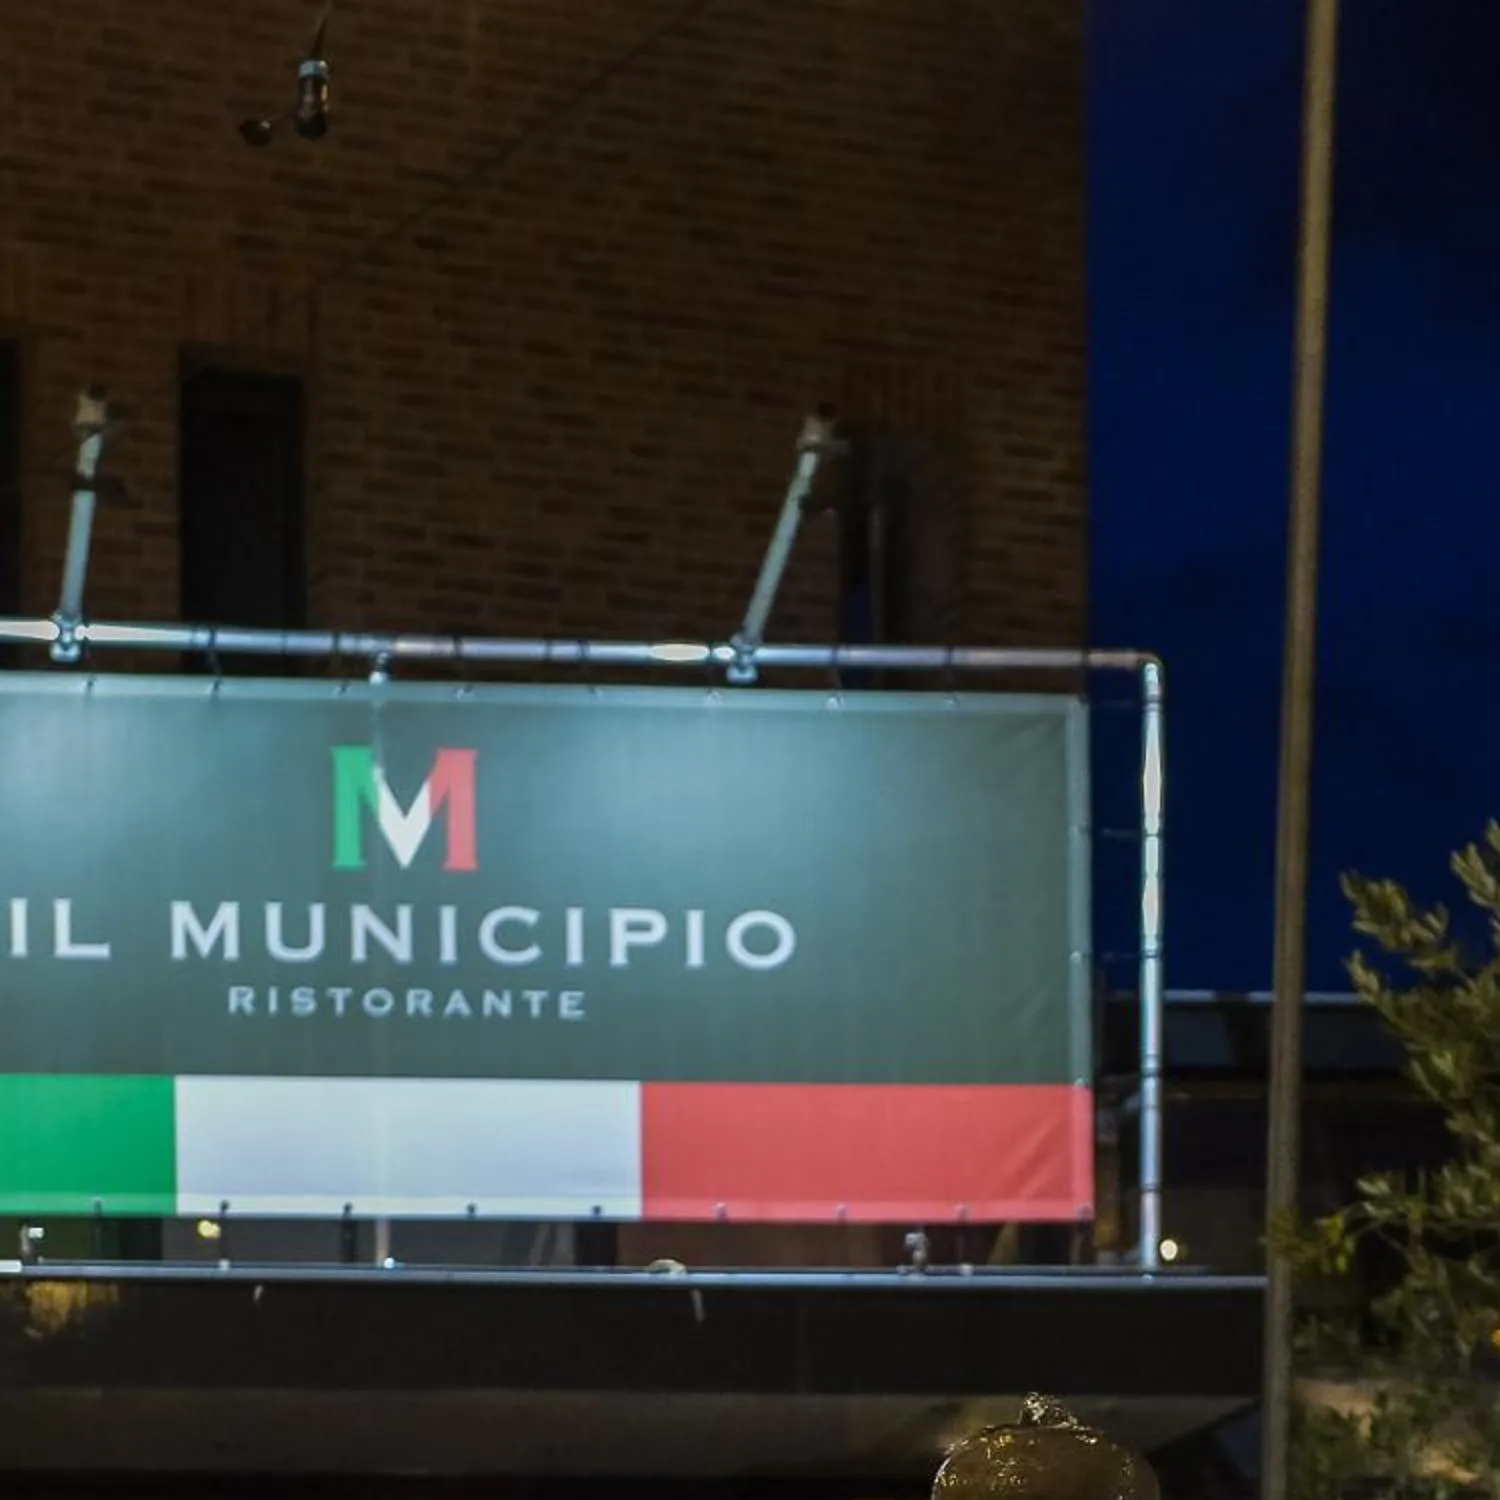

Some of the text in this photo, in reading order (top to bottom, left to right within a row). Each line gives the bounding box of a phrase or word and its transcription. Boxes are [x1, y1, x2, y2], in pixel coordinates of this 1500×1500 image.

[331, 745, 477, 871] M
[10, 898, 797, 970] IL MUNICIPIO
[228, 986, 585, 1020] RISTORANTE
